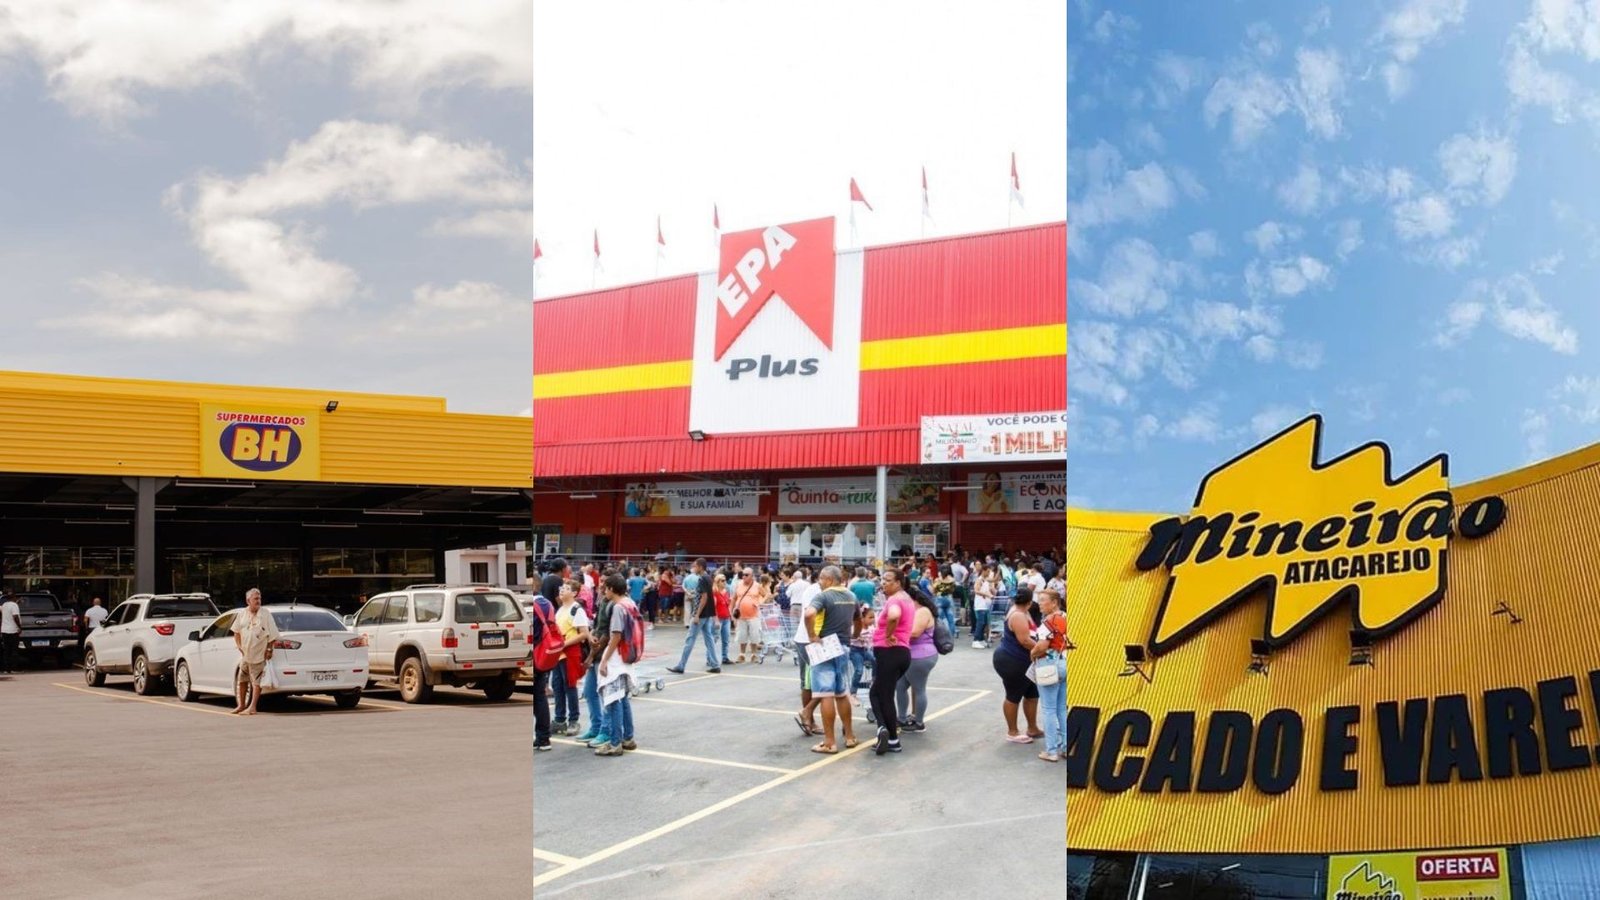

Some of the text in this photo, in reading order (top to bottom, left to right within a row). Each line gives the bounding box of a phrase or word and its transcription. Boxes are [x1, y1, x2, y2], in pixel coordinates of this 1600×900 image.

[717, 225, 797, 319] EPA
[725, 354, 819, 381] Plus
[216, 412, 305, 426] SUPERMERCADOS
[986, 414, 1019, 426] VOCÊ
[1023, 414, 1057, 424] PODE
[231, 426, 292, 463] BH
[677, 488, 712, 497] MELHOR
[788, 490, 839, 504] Quinta
[680, 501, 686, 509] E
[687, 501, 705, 509] SUA
[1033, 496, 1040, 510] É
[1135, 491, 1506, 571] Mineirão
[1283, 547, 1431, 584] ATACAREJO
[1320, 705, 1359, 791] E
[1421, 857, 1495, 875] OFERTA
